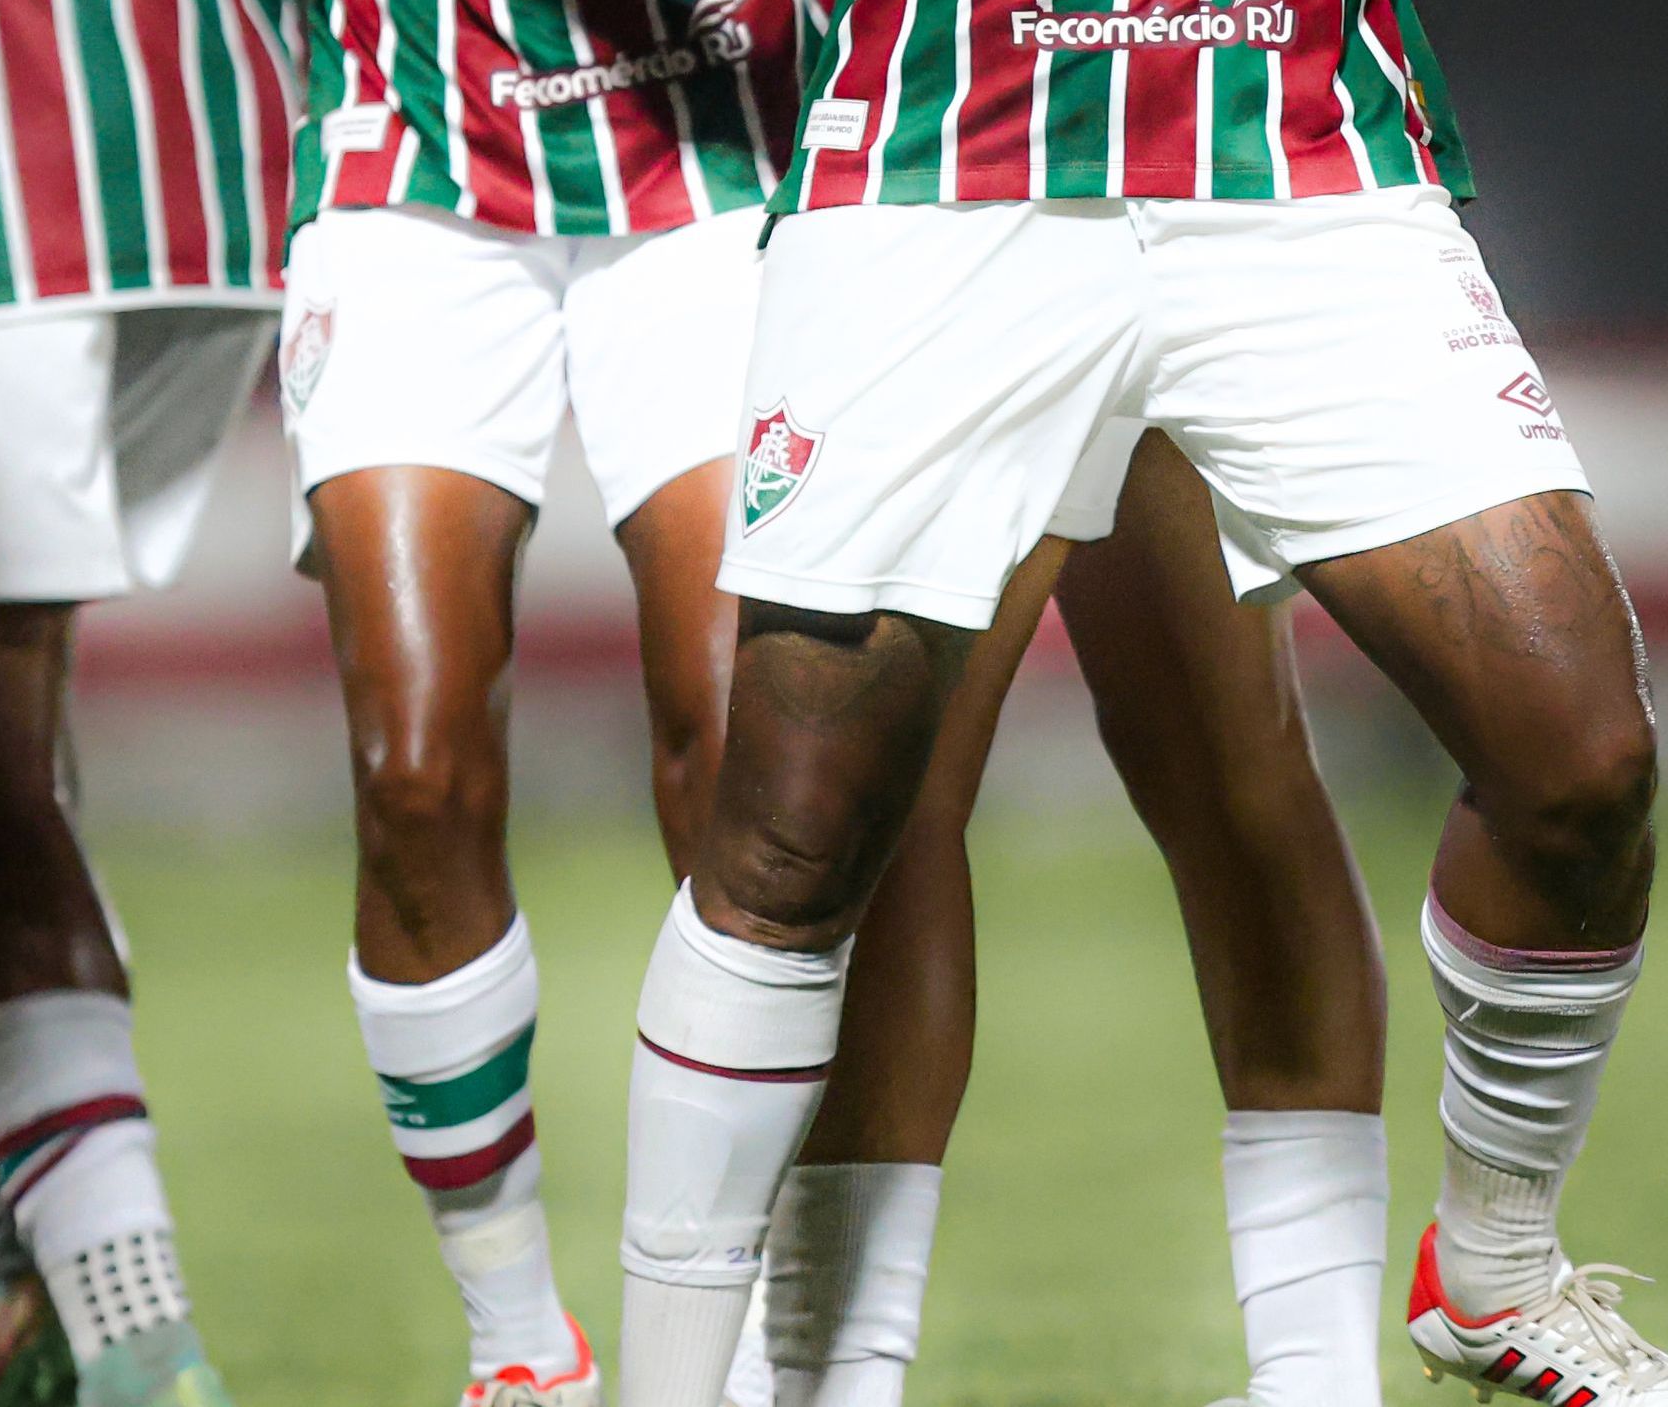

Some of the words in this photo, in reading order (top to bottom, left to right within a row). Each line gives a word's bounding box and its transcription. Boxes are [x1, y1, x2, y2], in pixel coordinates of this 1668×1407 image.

[1011, 5, 1236, 45] Fecomércio
[1246, 0, 1294, 44] RJ
[1448, 335, 1480, 353] RIO
[1481, 333, 1500, 346] DE
